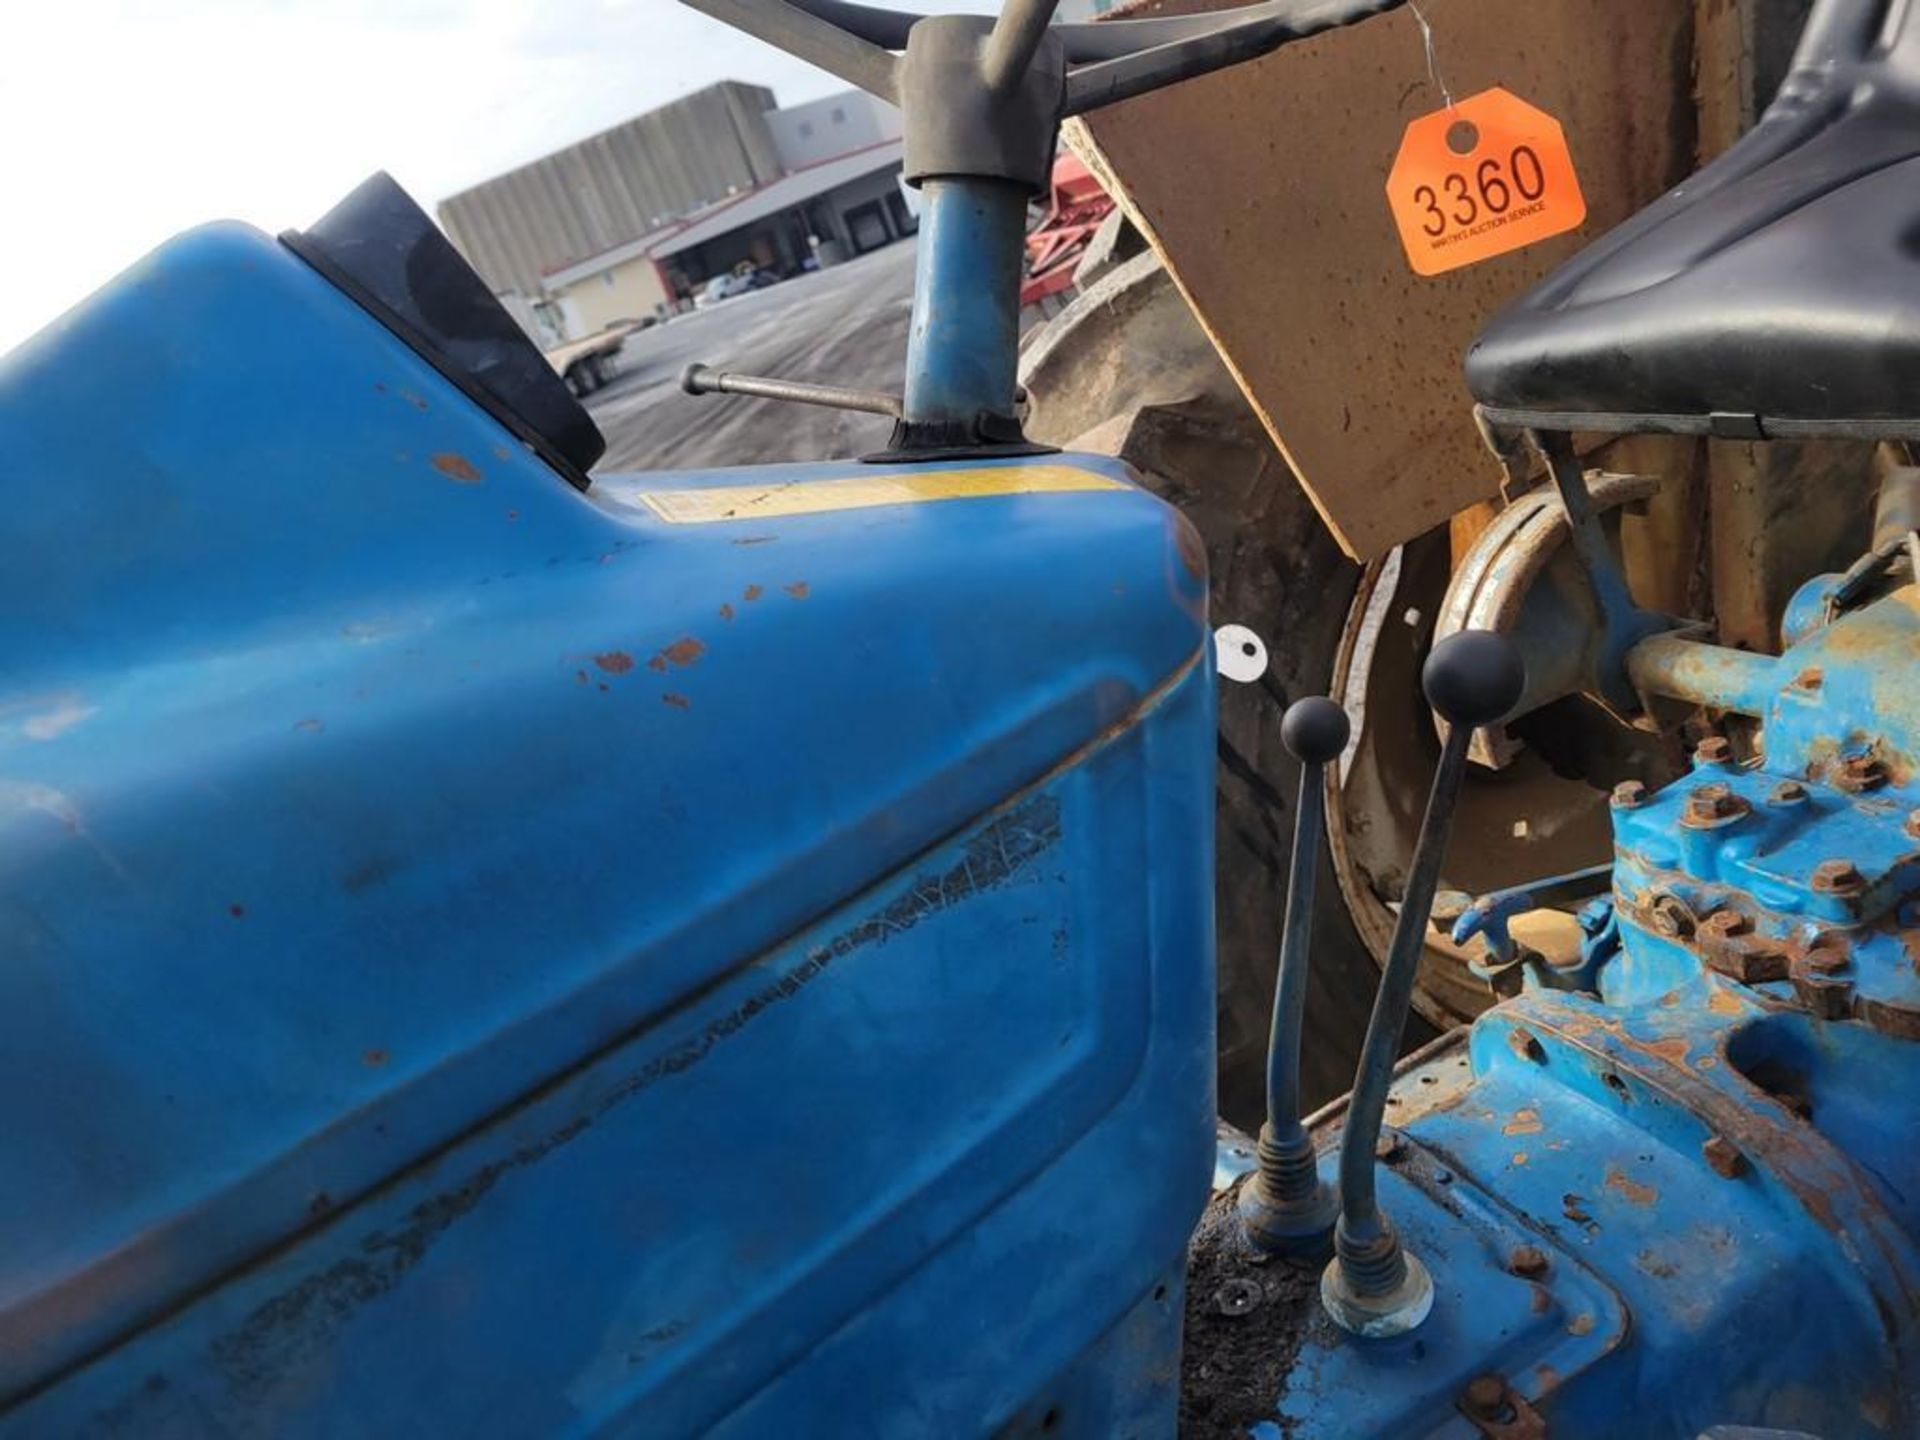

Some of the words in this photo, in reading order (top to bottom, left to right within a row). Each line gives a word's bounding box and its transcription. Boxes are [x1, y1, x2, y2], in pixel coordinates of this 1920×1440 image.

[1414, 145, 1545, 237] 3360
[1469, 215, 1507, 237] AUCTION
[1508, 200, 1546, 222] SERVICE
